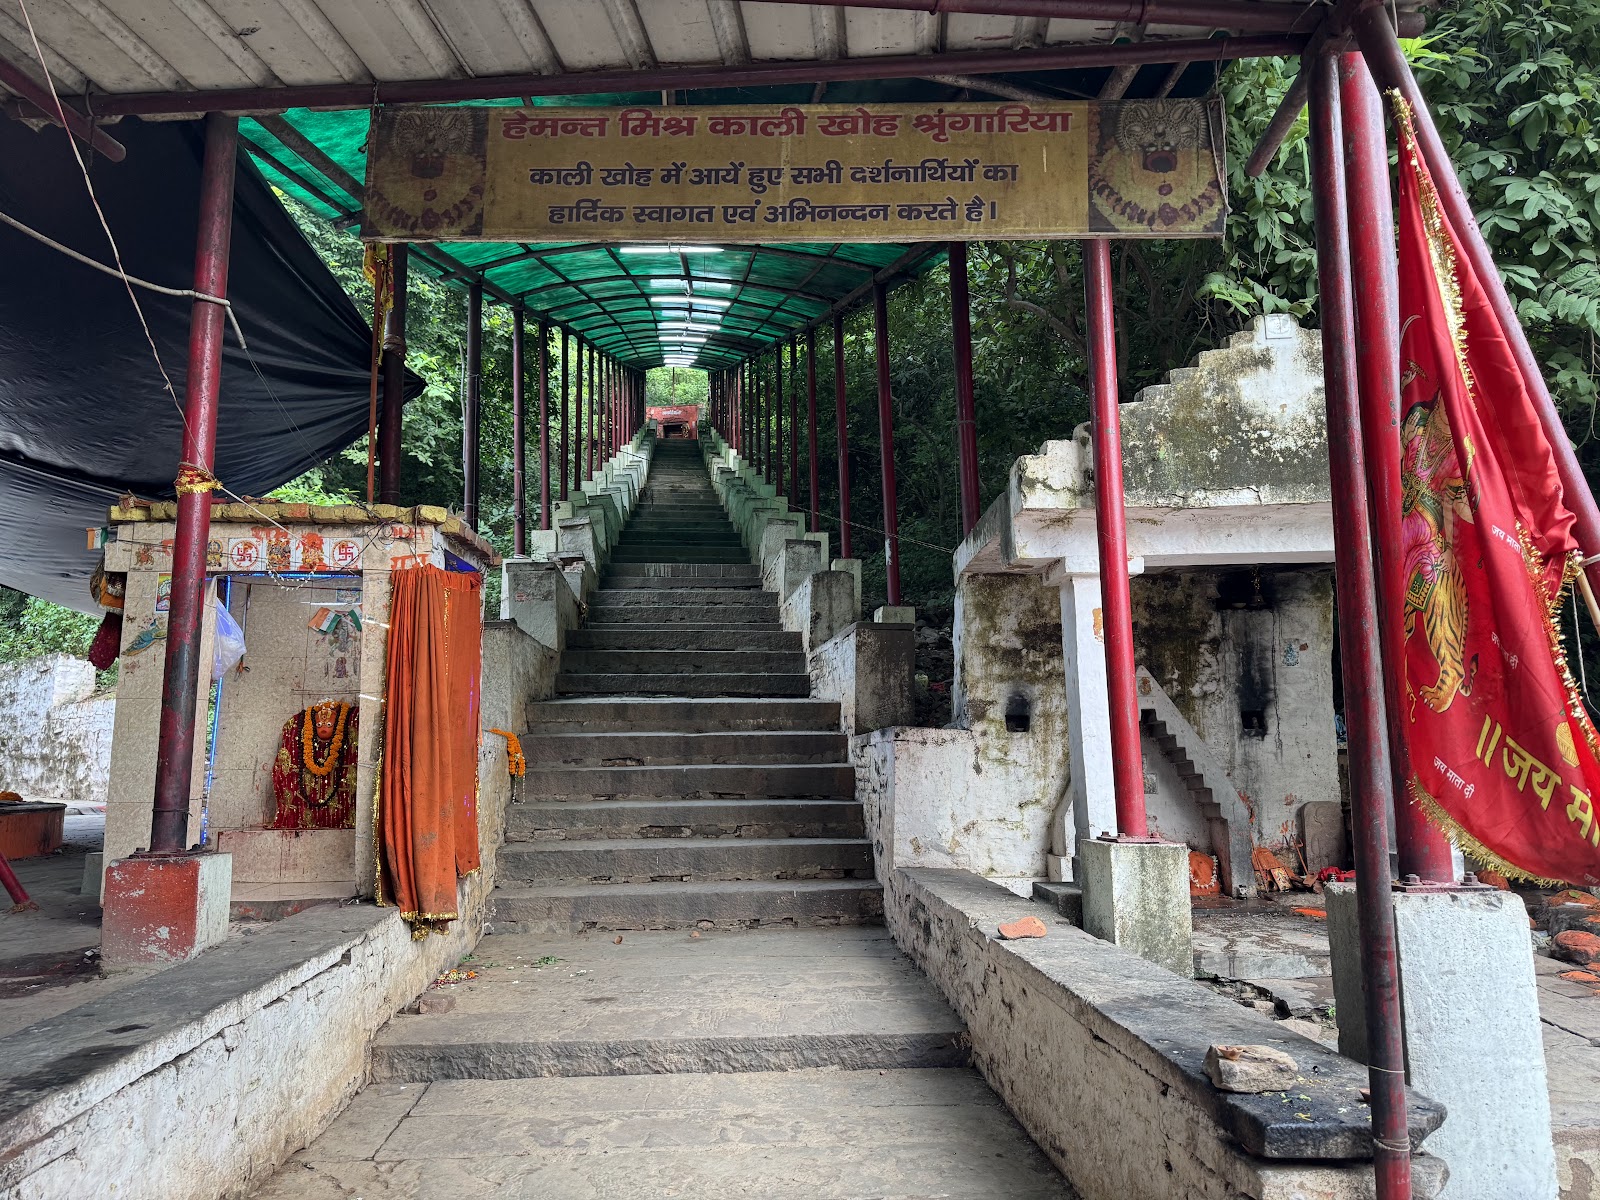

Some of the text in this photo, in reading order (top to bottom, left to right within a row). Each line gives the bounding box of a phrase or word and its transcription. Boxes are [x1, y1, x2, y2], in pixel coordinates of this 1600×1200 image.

[501, 110, 610, 140] हेमन्त
[618, 108, 698, 138] मिश्र
[708, 107, 808, 136] काली
[817, 107, 902, 137] खोह
[529, 158, 1019, 194] काली खोह में आयें हुए सभी दर्शनार्थियों का
[548, 198, 627, 224] हार्दिक
[632, 205, 716, 223] स्वागत
[721, 198, 762, 224] एवं
[763, 197, 891, 223] अभिनन्दन
[896, 196, 959, 221] करते
[1433, 755, 1475, 799] जय माता दी
